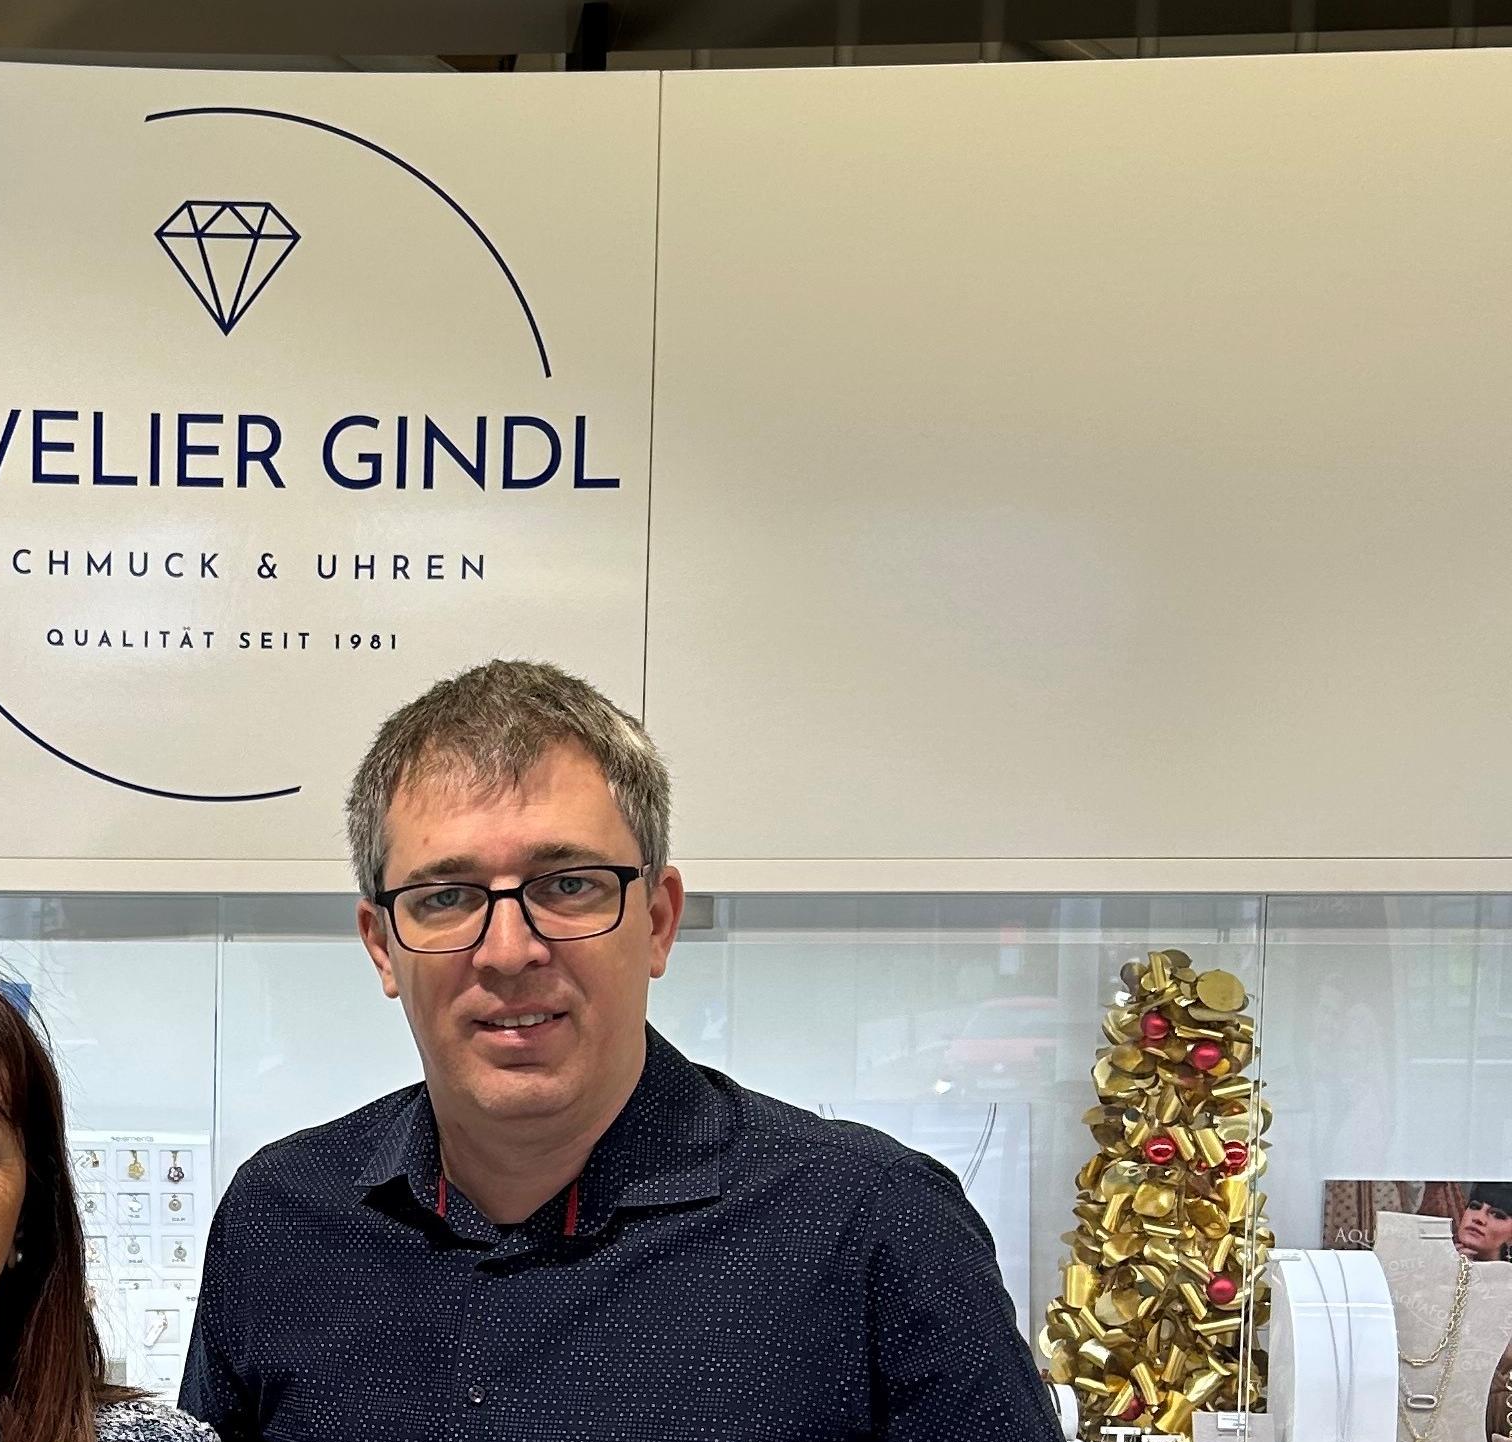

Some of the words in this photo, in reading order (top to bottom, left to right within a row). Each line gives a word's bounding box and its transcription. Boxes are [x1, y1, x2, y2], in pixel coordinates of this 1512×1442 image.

[321, 413, 621, 491] GINDL
[256, 553, 279, 581] &
[317, 553, 488, 582] UHREN
[45, 626, 216, 650] QUALITÄT
[238, 631, 312, 650] SEIT
[334, 632, 400, 651] 1981
